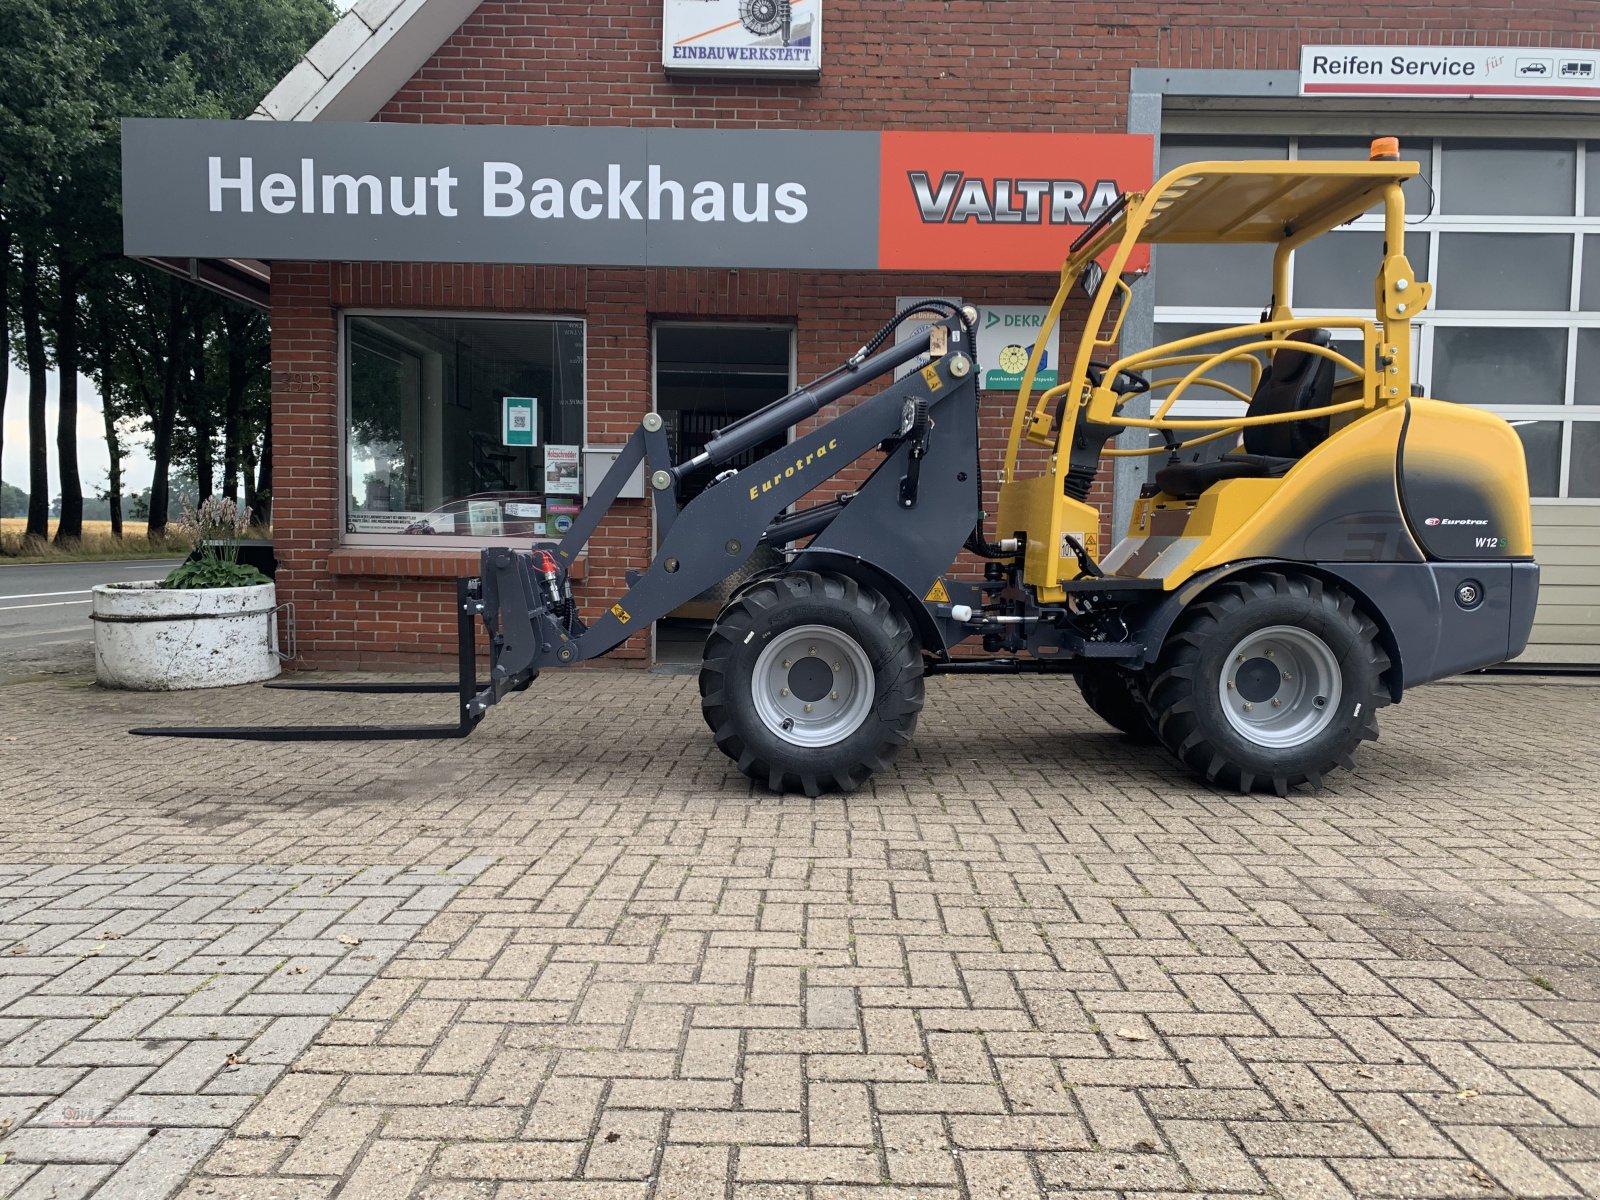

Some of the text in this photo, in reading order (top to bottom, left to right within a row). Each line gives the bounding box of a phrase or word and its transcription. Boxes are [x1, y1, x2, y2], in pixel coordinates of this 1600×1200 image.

[672, 46, 812, 61] EINBAUWERKSTATT
[1312, 55, 1505, 77] Reifen Service für
[207, 156, 809, 224] Helmut Backhaus
[907, 170, 1121, 225] VALTRA
[749, 438, 837, 501] Eurotrac
[1475, 537, 1498, 548] W12
